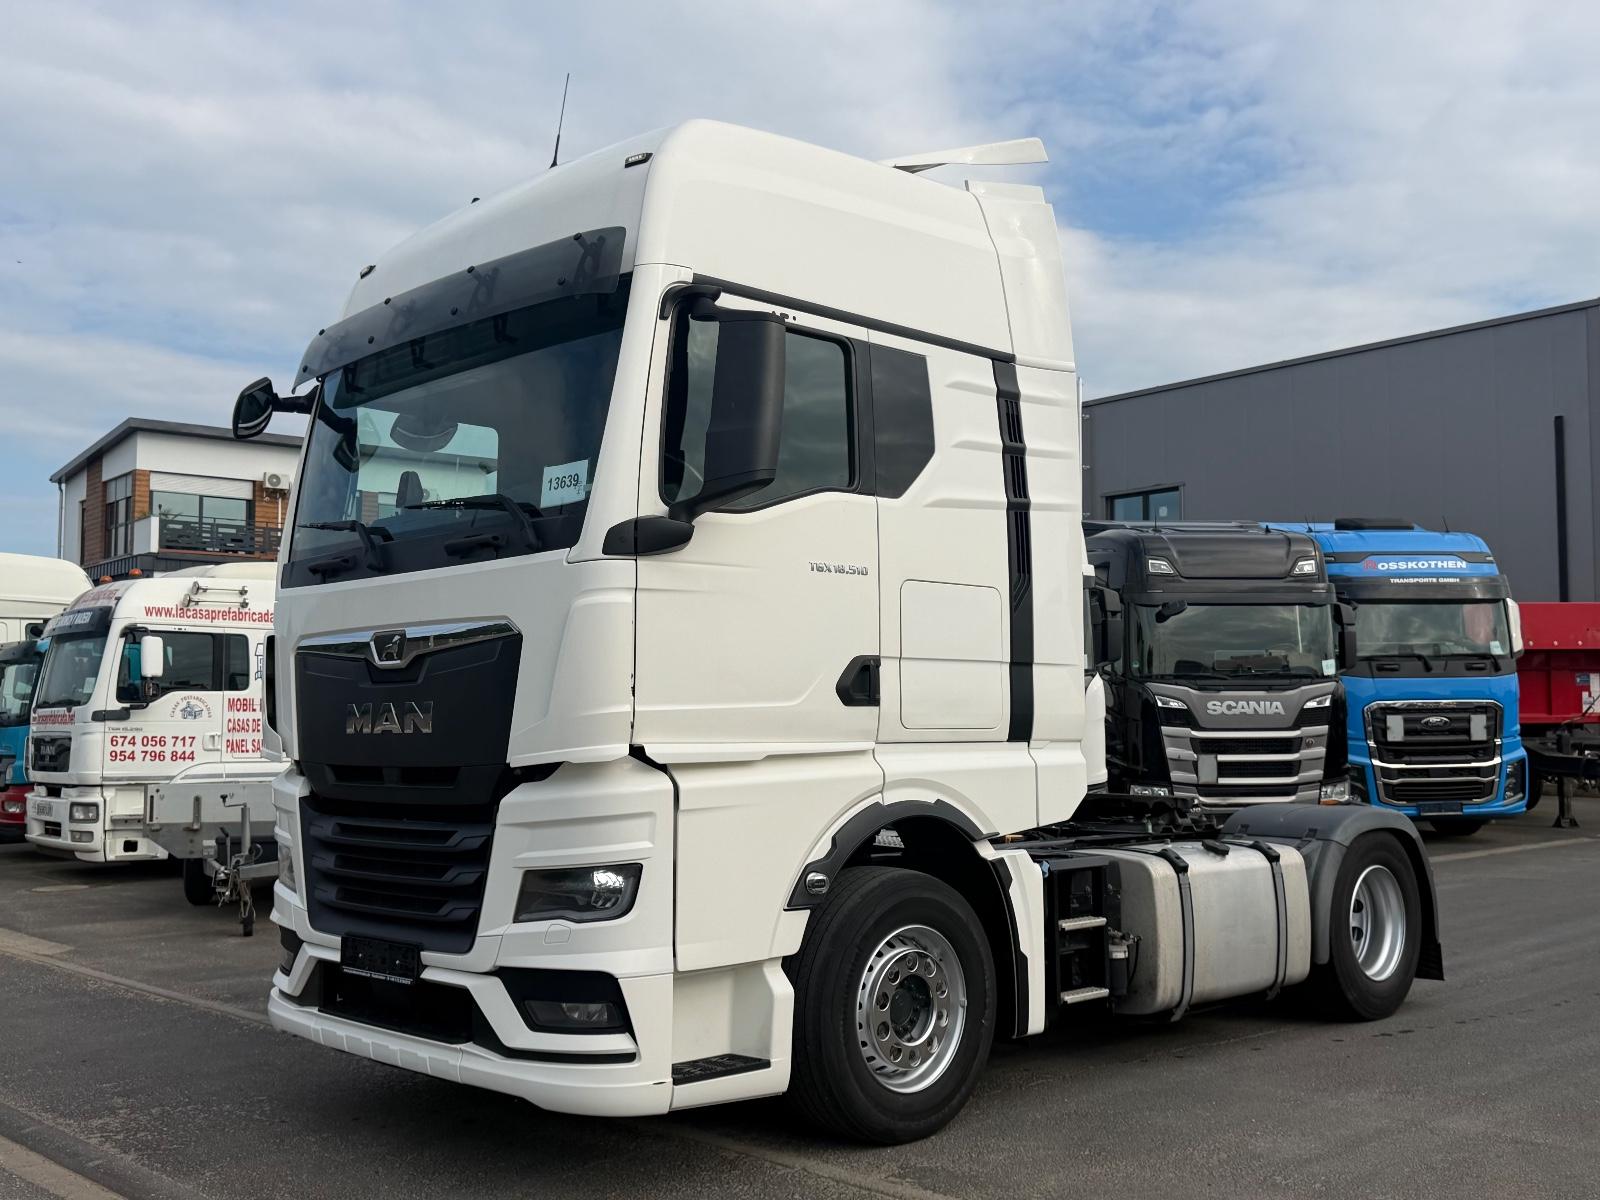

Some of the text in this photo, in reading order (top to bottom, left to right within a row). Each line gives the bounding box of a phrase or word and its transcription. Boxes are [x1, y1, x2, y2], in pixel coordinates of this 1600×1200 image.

[548, 473, 580, 491] 13639
[227, 697, 257, 713] MOBIL
[1206, 700, 1286, 715] SCANIA
[346, 701, 433, 734] MAN
[227, 718, 261, 733] CASAS DE
[110, 735, 196, 748] 674 056 717
[225, 738, 264, 753] PANEL SA
[109, 750, 196, 762] 954 796 844
